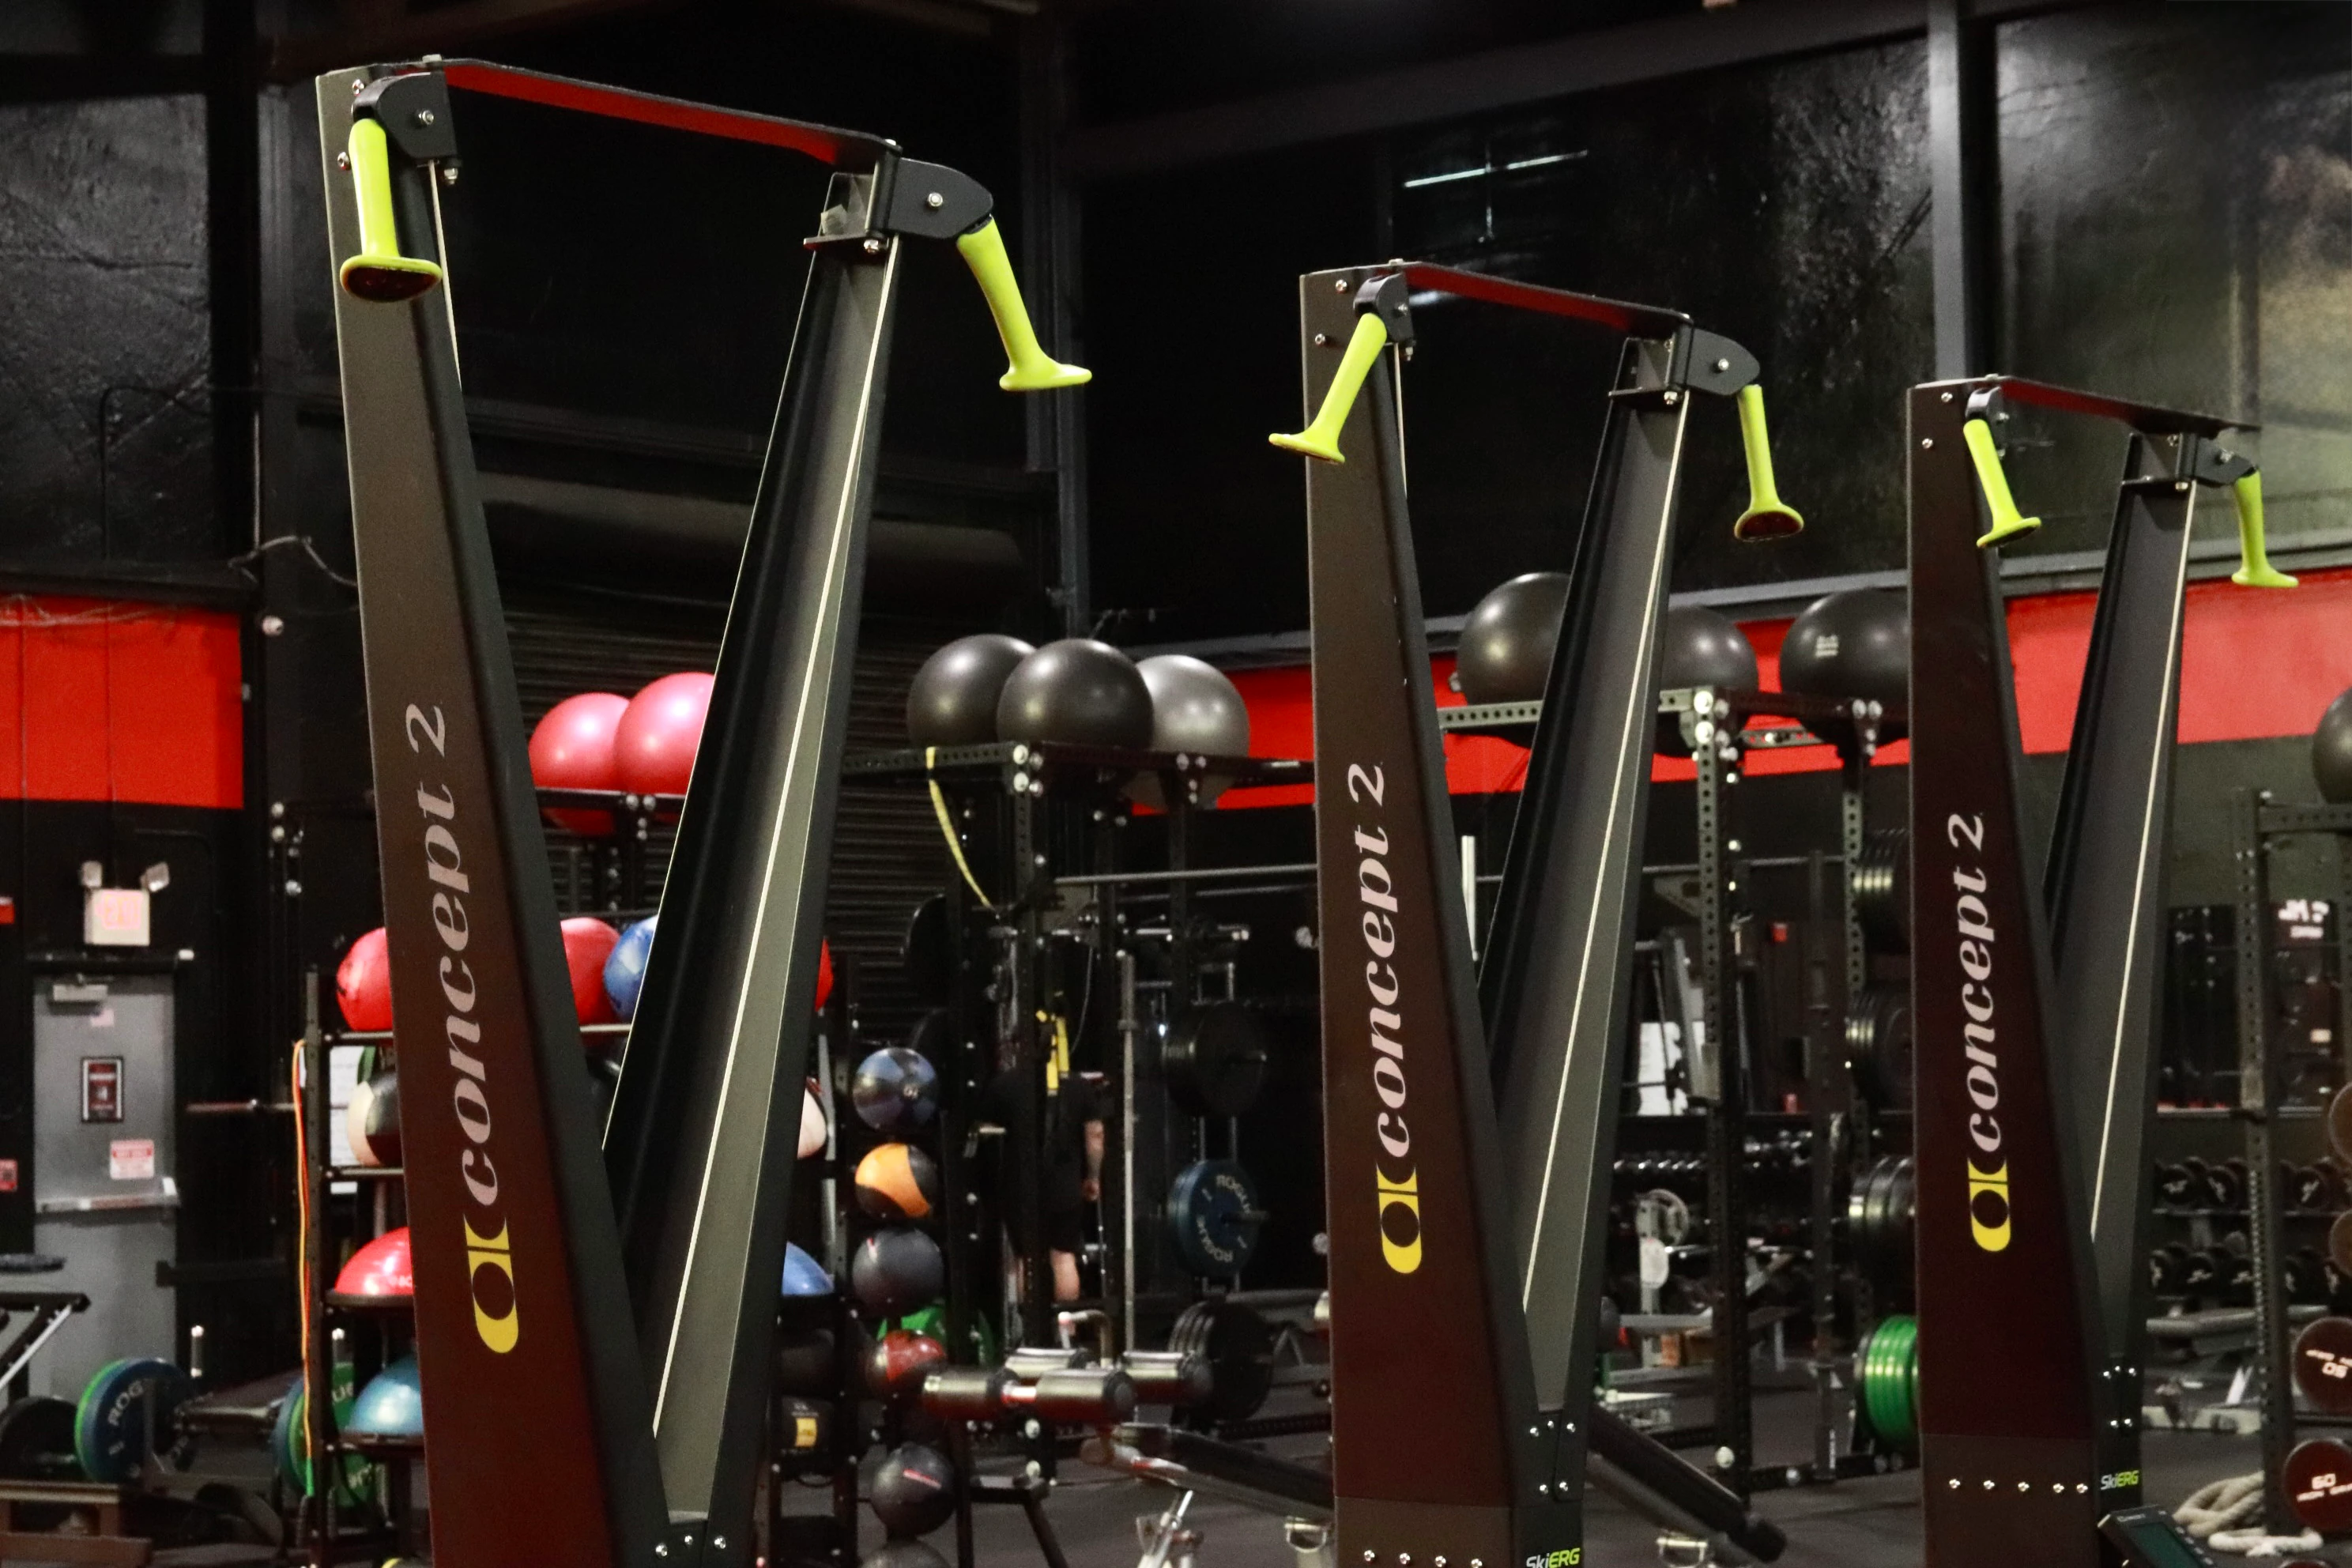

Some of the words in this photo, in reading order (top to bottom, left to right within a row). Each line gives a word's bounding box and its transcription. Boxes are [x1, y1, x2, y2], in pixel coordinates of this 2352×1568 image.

[405, 703, 447, 759] 2
[1348, 763, 1386, 807] 2
[1947, 813, 1984, 851] 2
[416, 781, 499, 1206] concept
[1353, 824, 1411, 1159] concept
[1952, 865, 2001, 1153] concept
[2101, 1470, 2139, 1491] SkiERG
[1526, 1547, 1580, 1568] SkiERG
